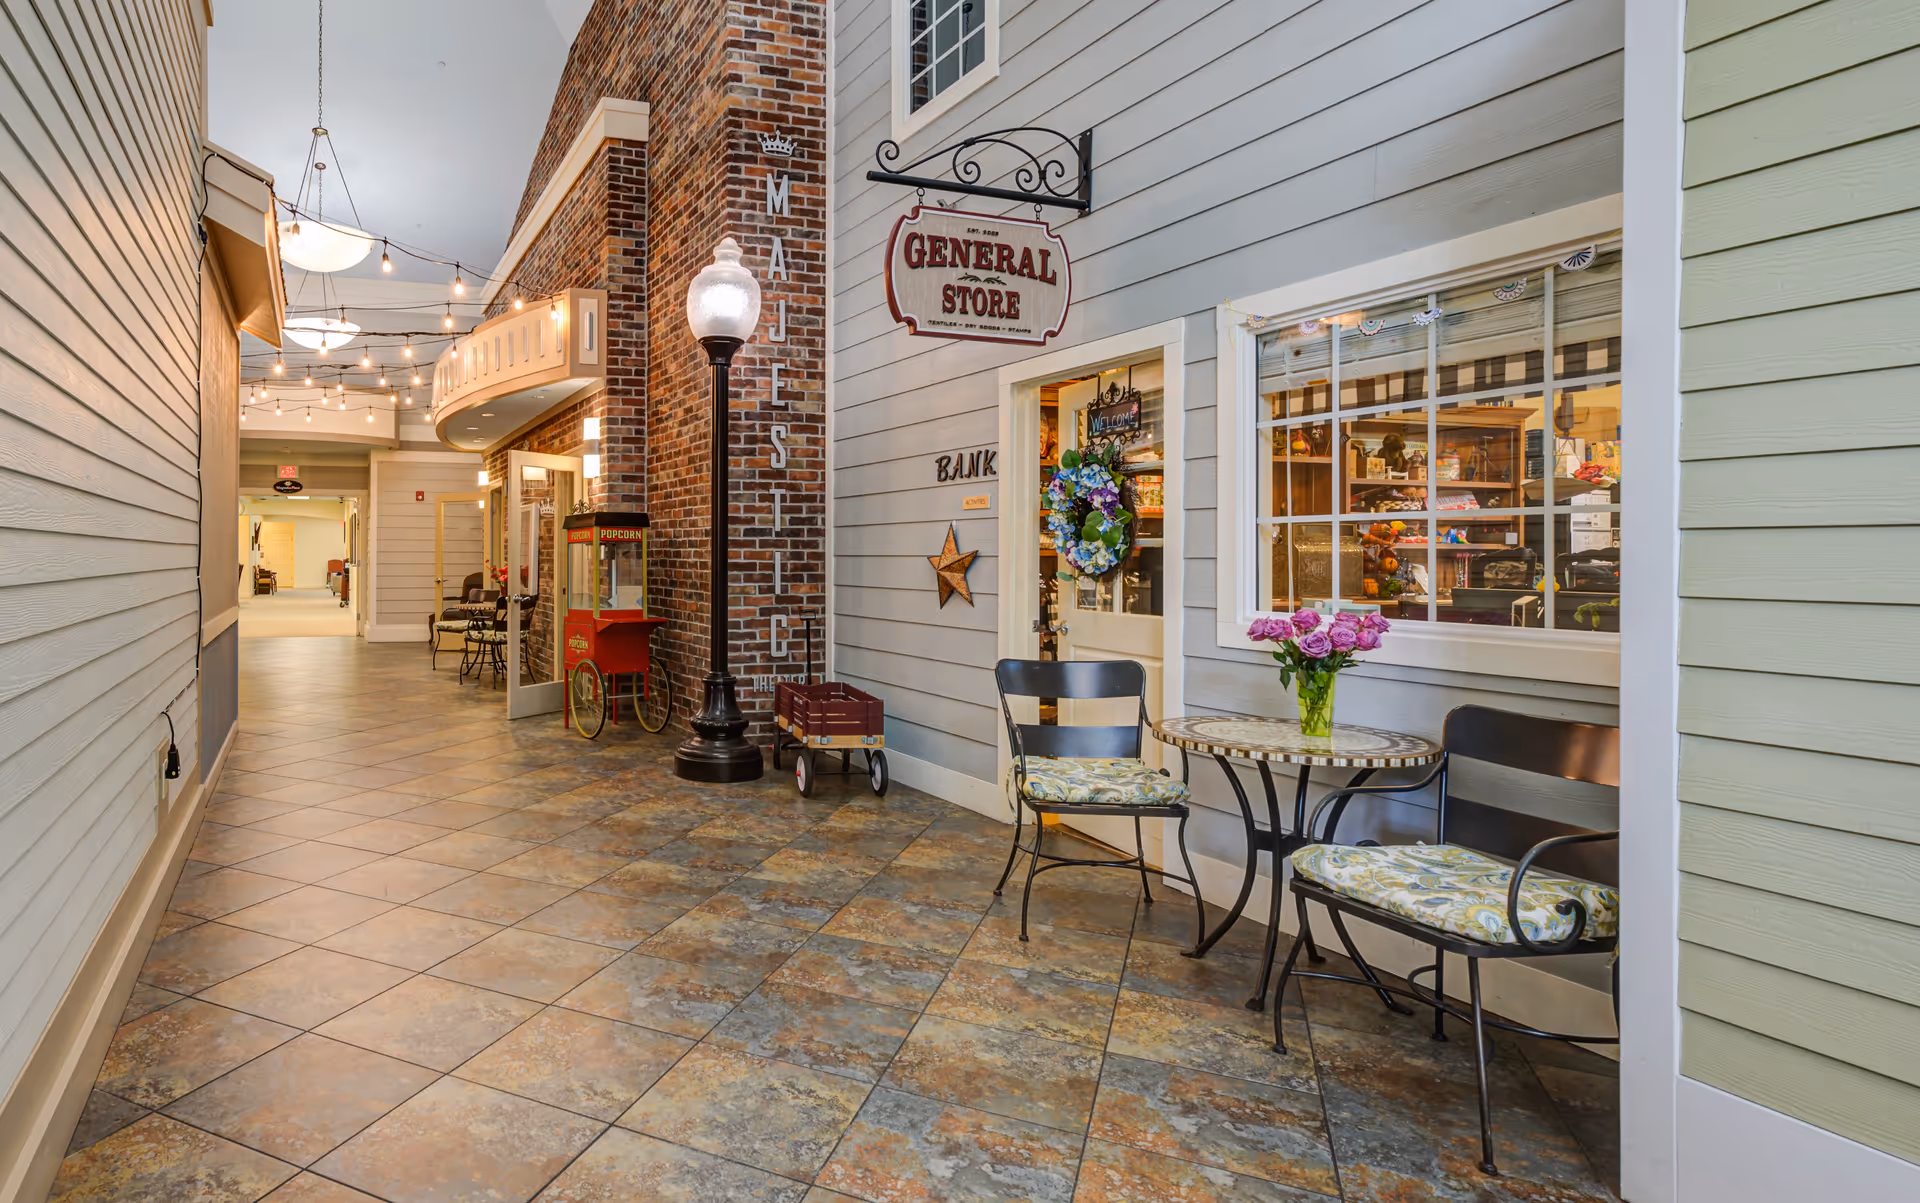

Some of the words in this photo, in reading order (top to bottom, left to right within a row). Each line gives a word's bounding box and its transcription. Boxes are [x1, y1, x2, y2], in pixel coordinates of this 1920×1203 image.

[903, 232, 1056, 286] GENERAL
[942, 283, 1020, 319] STORE
[767, 172, 789, 658] MAJESTIC
[1089, 411, 1136, 433] WELCOME
[935, 449, 997, 482] BANK
[571, 530, 591, 540] POPCORN
[600, 529, 642, 540] POPCORN
[568, 638, 589, 650] POPCORN
